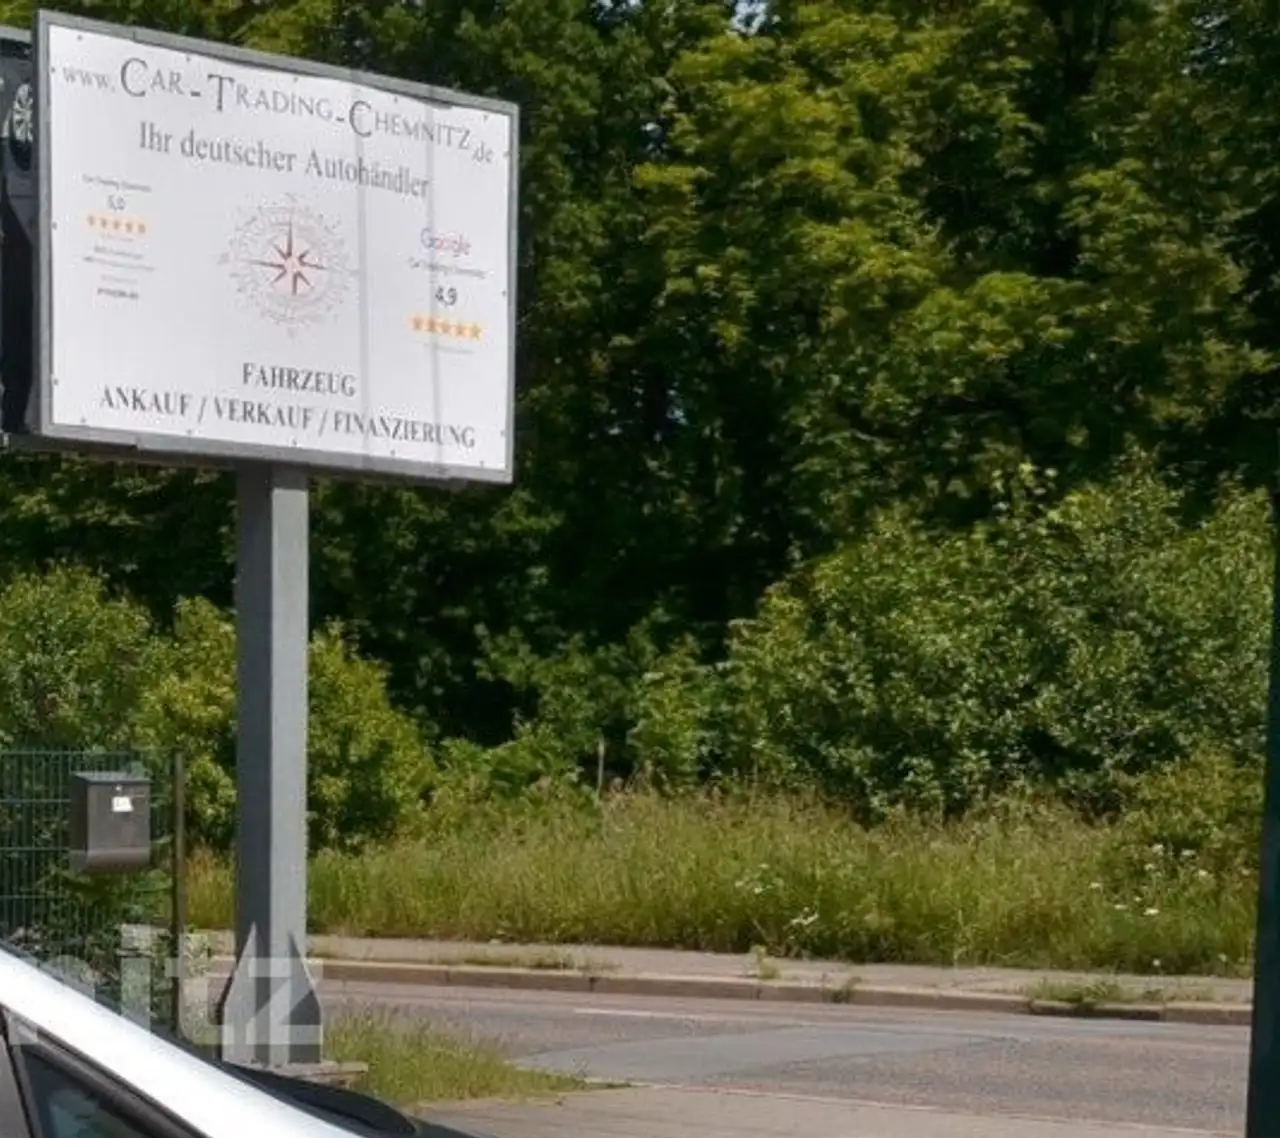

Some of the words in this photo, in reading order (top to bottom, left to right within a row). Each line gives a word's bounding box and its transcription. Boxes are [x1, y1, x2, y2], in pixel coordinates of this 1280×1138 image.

[139, 121, 173, 153] Ihr
[180, 129, 297, 172] deutscher
[305, 149, 430, 198] Autohändler
[420, 227, 472, 258] Google
[242, 361, 357, 397] FAHRZEUG
[99, 384, 193, 416] ANKAUF
[214, 395, 314, 430] VERKAUF
[334, 411, 476, 448] FINANZIERUNG
